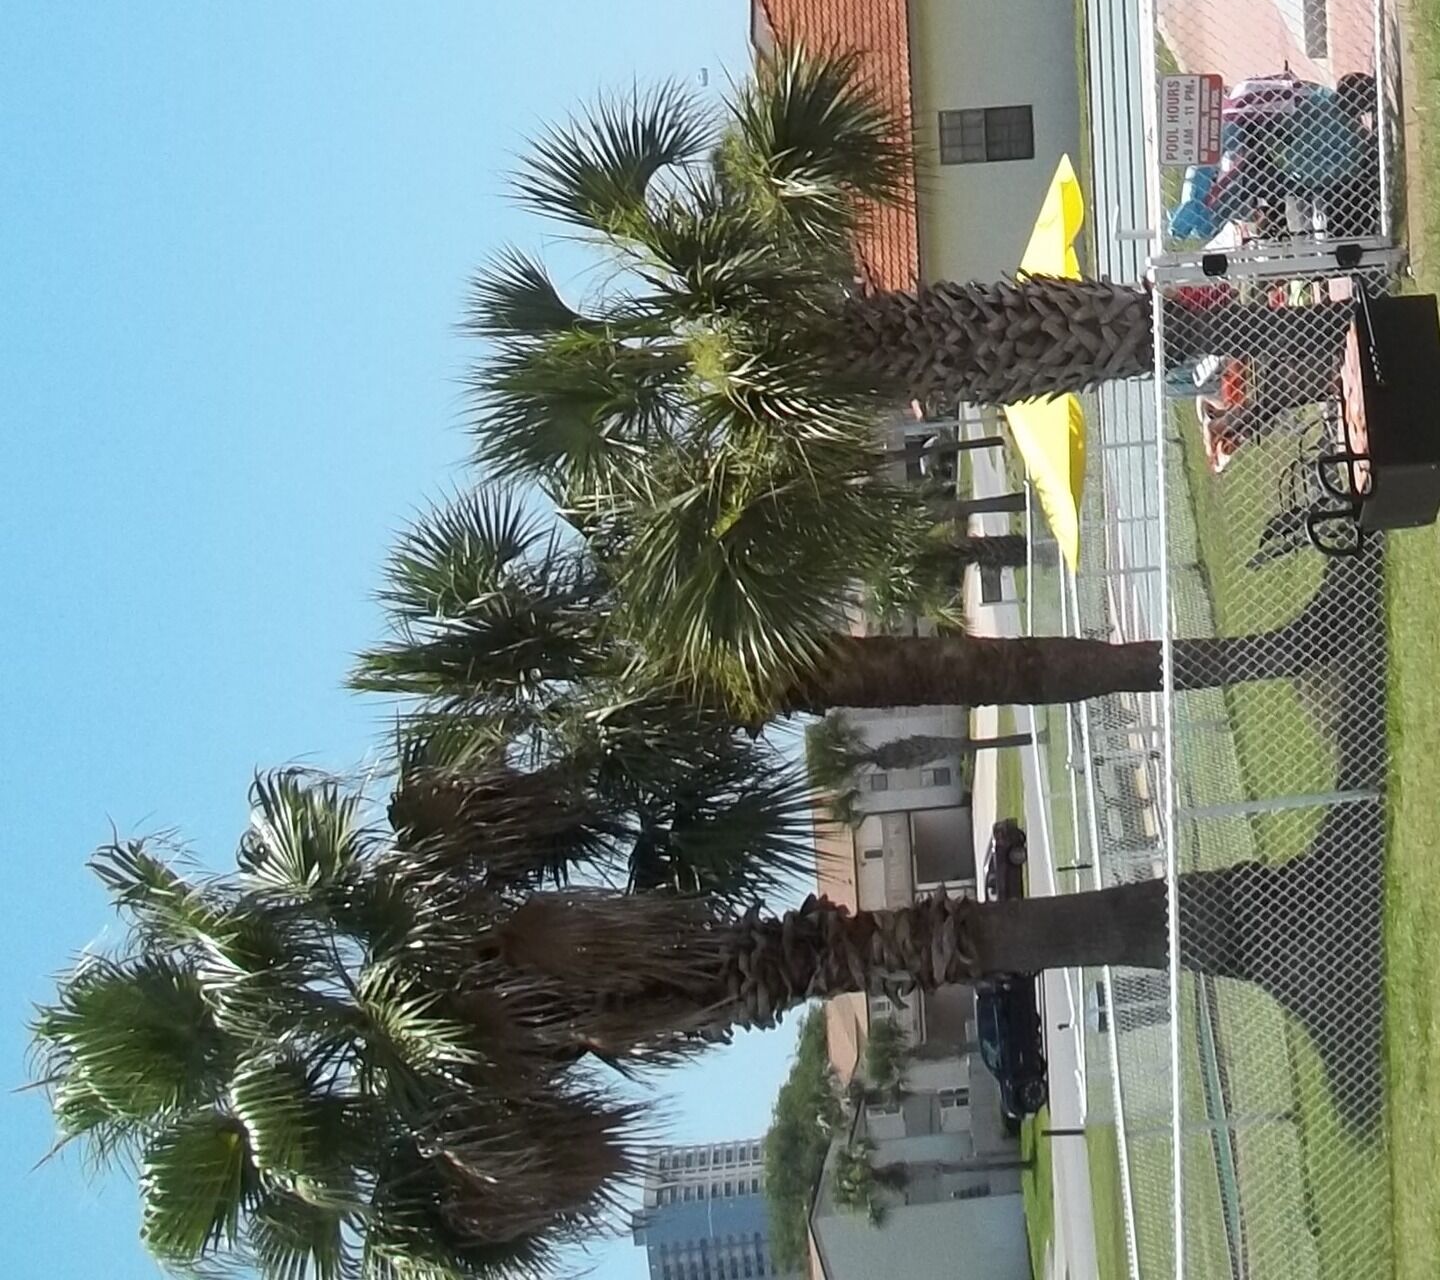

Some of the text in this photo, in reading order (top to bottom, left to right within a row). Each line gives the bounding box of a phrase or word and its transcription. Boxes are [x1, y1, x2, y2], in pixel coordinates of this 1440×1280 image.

[1184, 85, 1195, 101] PM
[1184, 106, 1195, 116] 11
[1166, 80, 1180, 160] POOL HOURS
[1184, 128, 1194, 146] AM
